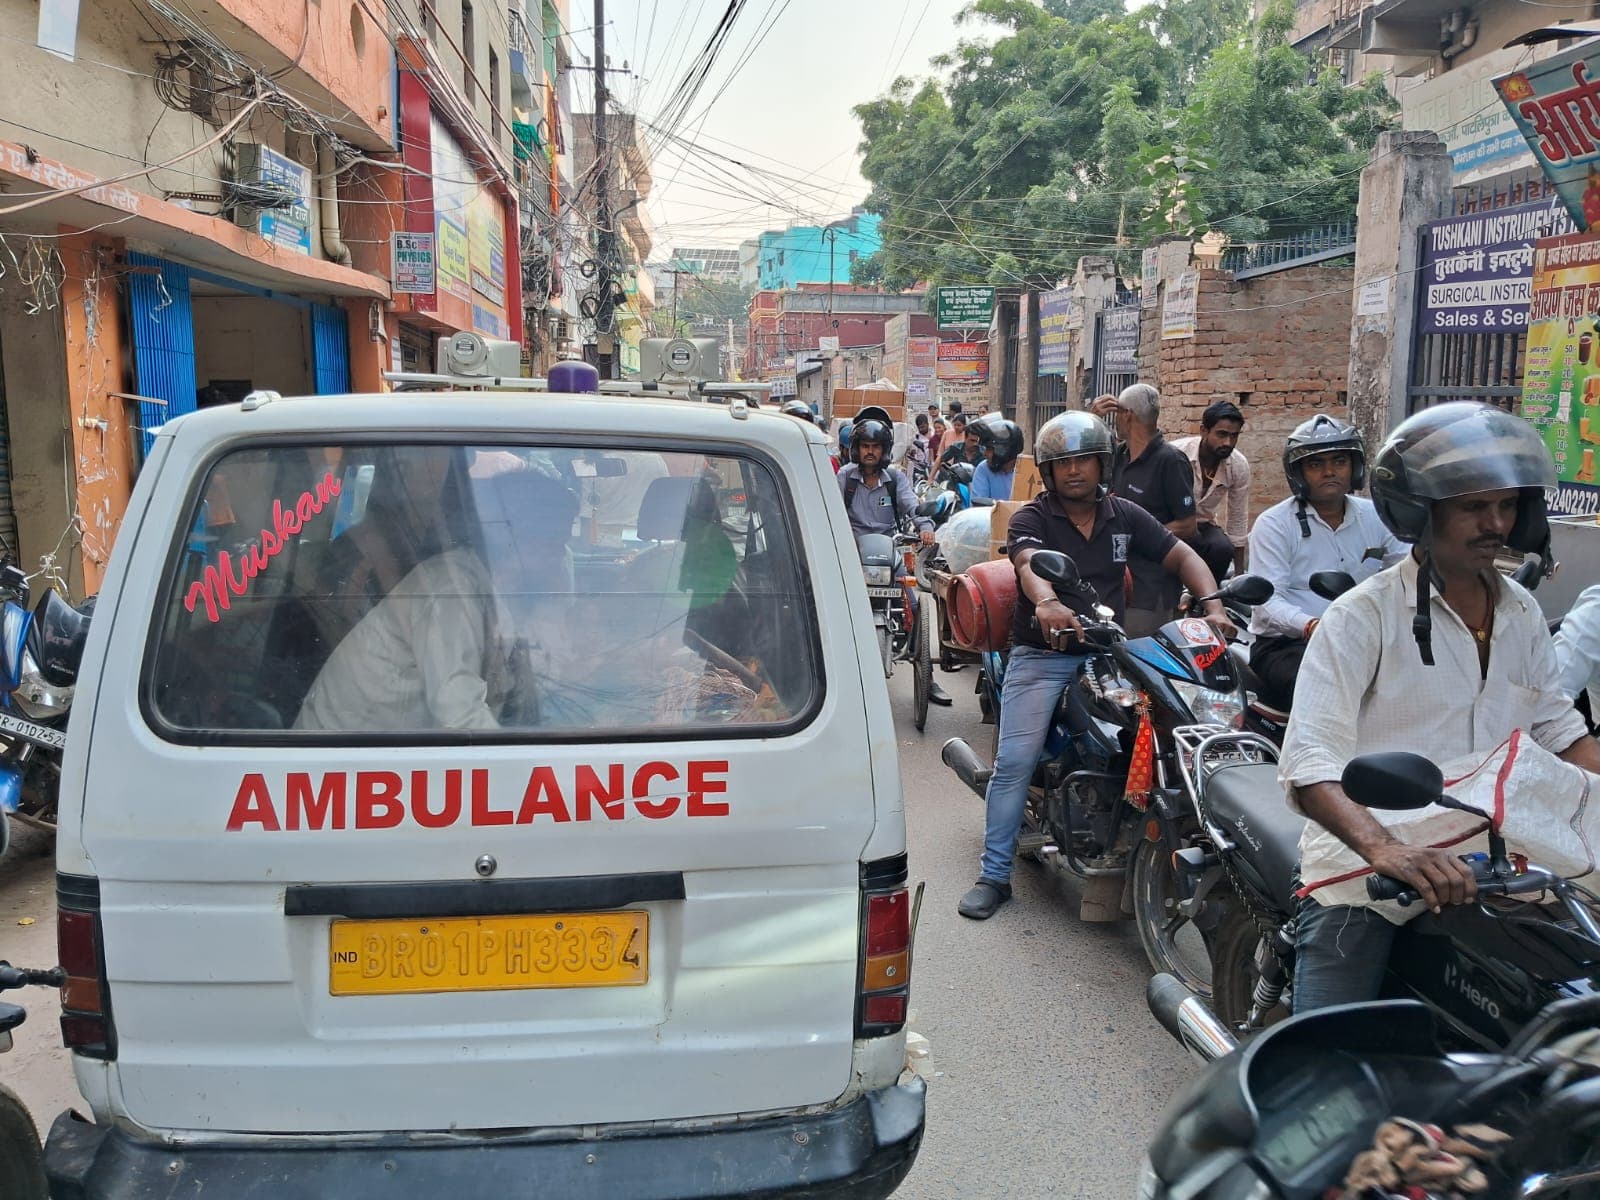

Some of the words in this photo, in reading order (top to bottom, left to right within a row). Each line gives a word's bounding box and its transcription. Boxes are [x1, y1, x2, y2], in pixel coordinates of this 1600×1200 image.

[396, 239, 417, 249] B.Sc
[1432, 219, 1483, 251] TUSHKANI
[1484, 206, 1568, 245] INSTRUMENTS
[397, 251, 432, 263] PHYSICS
[1431, 281, 1486, 305] SURGICAL
[1435, 310, 1478, 327] Sales
[1483, 309, 1496, 325] &
[184, 472, 342, 623] Muskan
[225, 760, 730, 832] AMBULANCE
[333, 951, 358, 963] IND
[362, 926, 642, 978] BR01PH3334
[1460, 979, 1500, 1019] Hero
